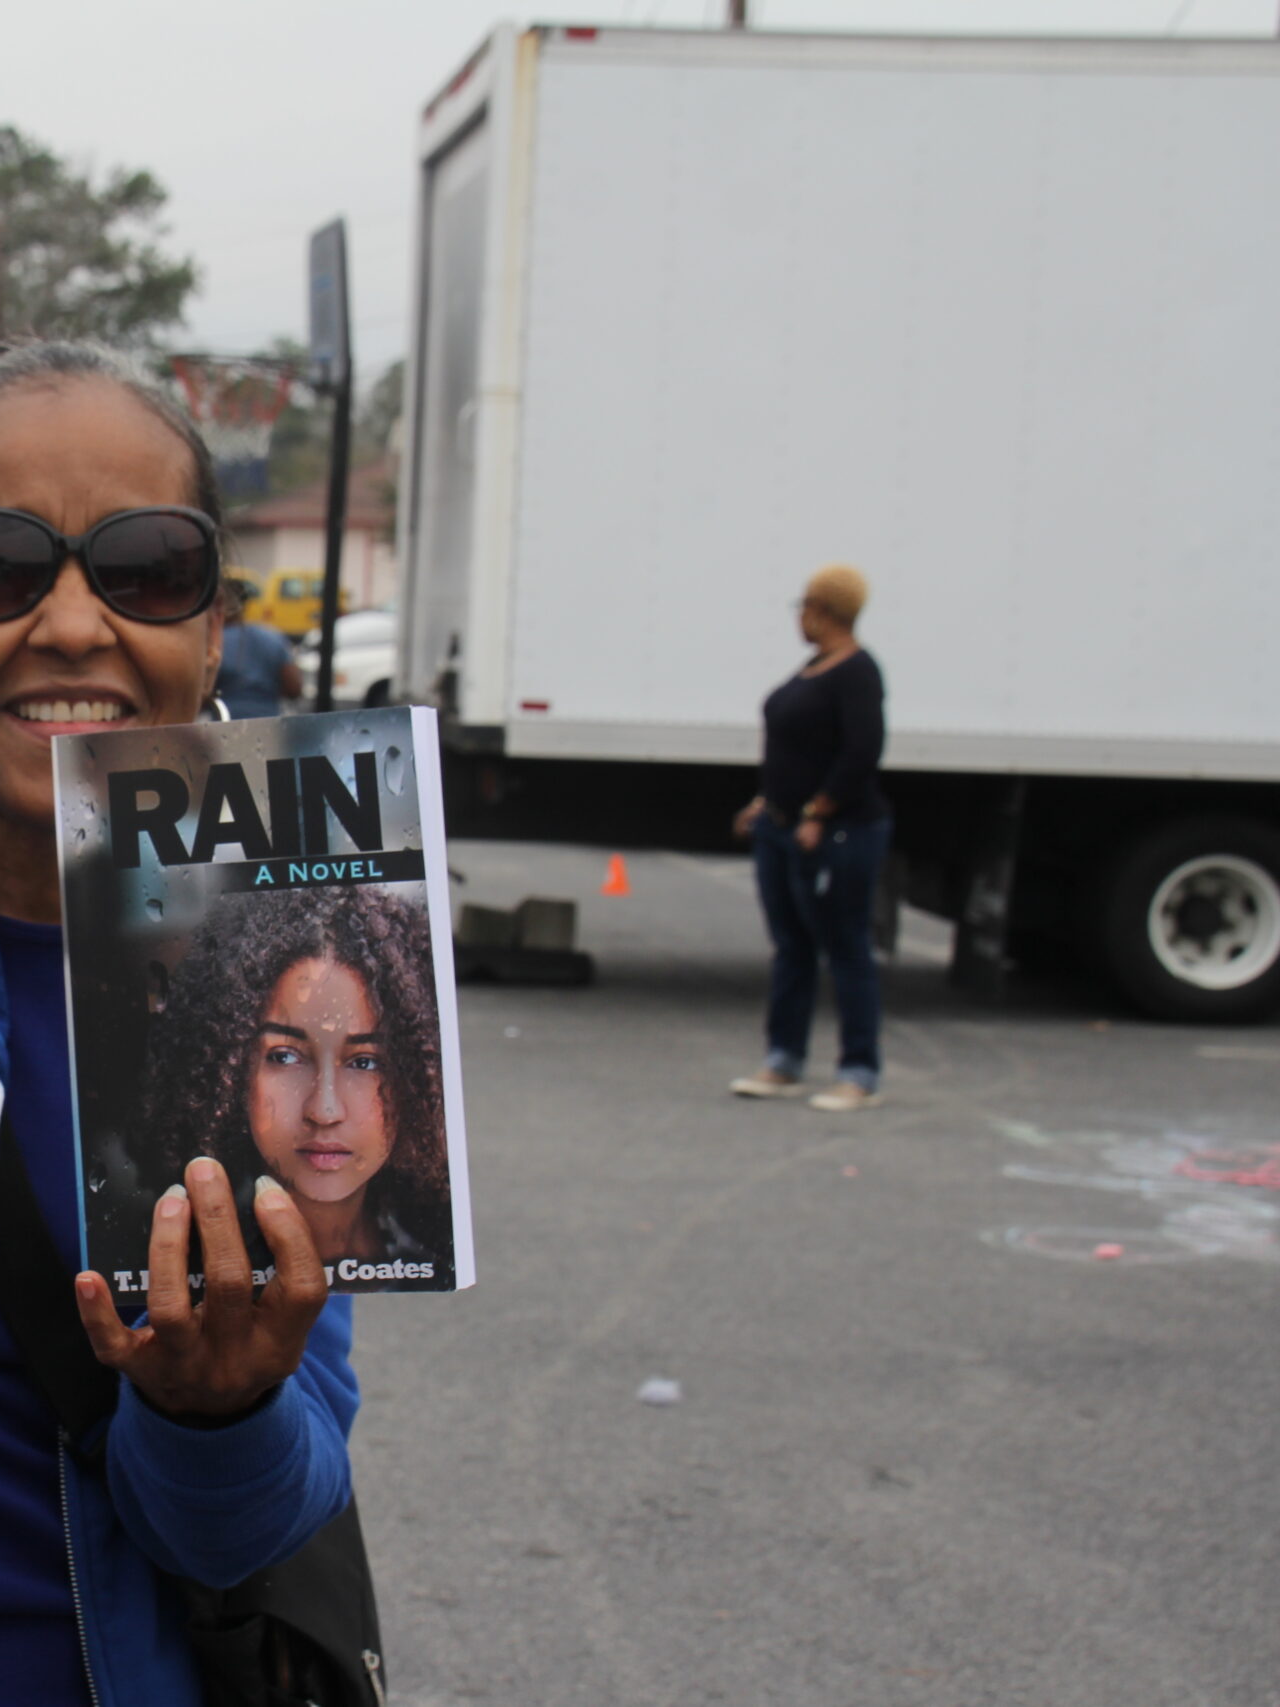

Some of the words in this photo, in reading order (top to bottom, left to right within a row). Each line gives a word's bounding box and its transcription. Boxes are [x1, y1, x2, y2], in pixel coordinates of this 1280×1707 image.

[107, 751, 384, 869] RAIN
[254, 864, 275, 886] A
[337, 1258, 435, 1281] Coates
